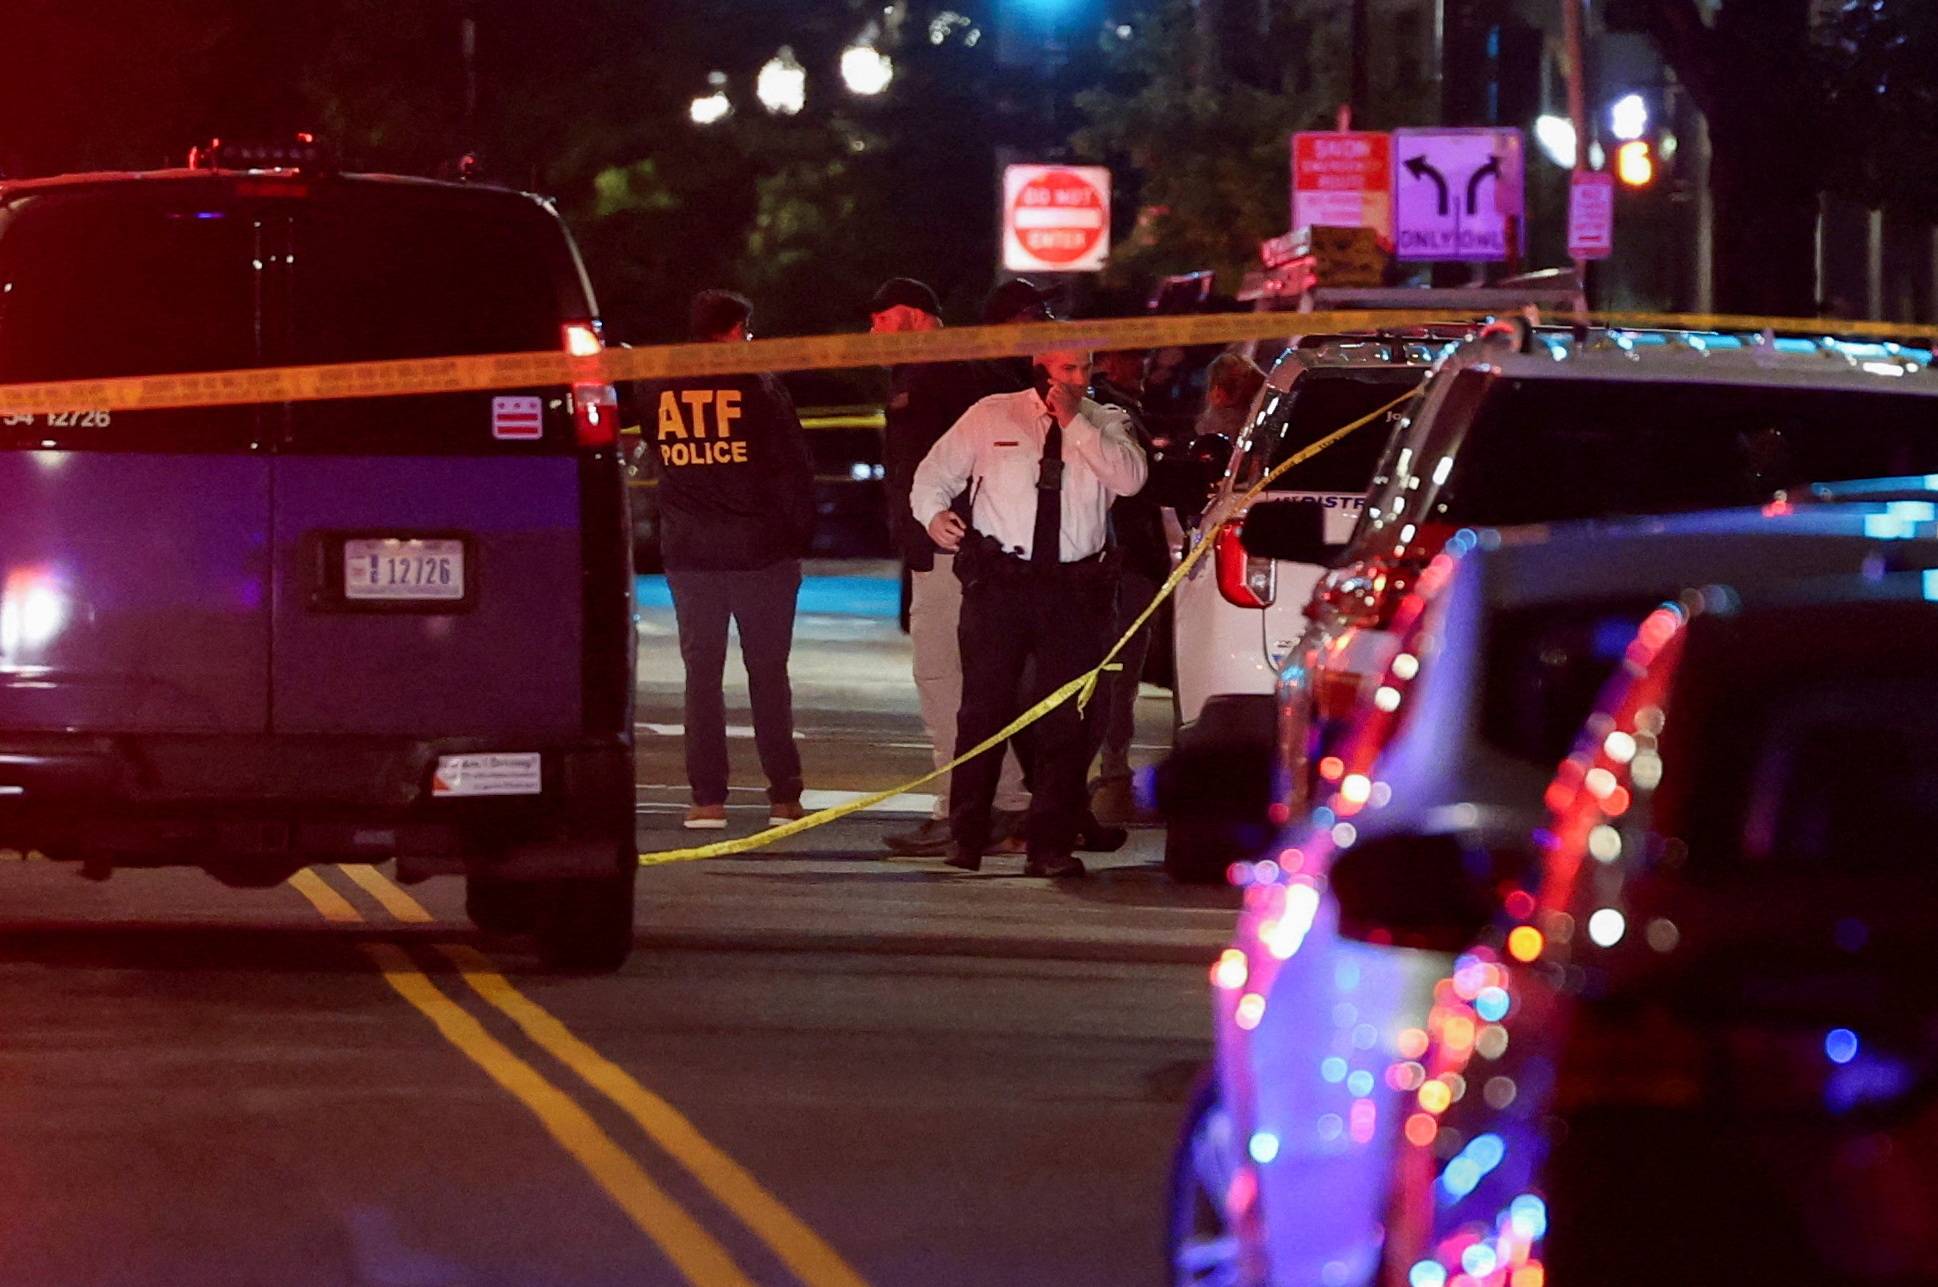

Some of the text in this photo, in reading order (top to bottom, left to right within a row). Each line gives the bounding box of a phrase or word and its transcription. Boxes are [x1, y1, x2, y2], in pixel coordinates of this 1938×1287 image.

[1023, 186, 1093, 206] DO NOT
[1027, 230, 1087, 250] ENTER
[1401, 230, 1455, 248] ONLY
[46, 408, 112, 428] 12726
[658, 389, 742, 440] ATF
[660, 441, 748, 466] POLICE
[387, 557, 451, 585] 12726
